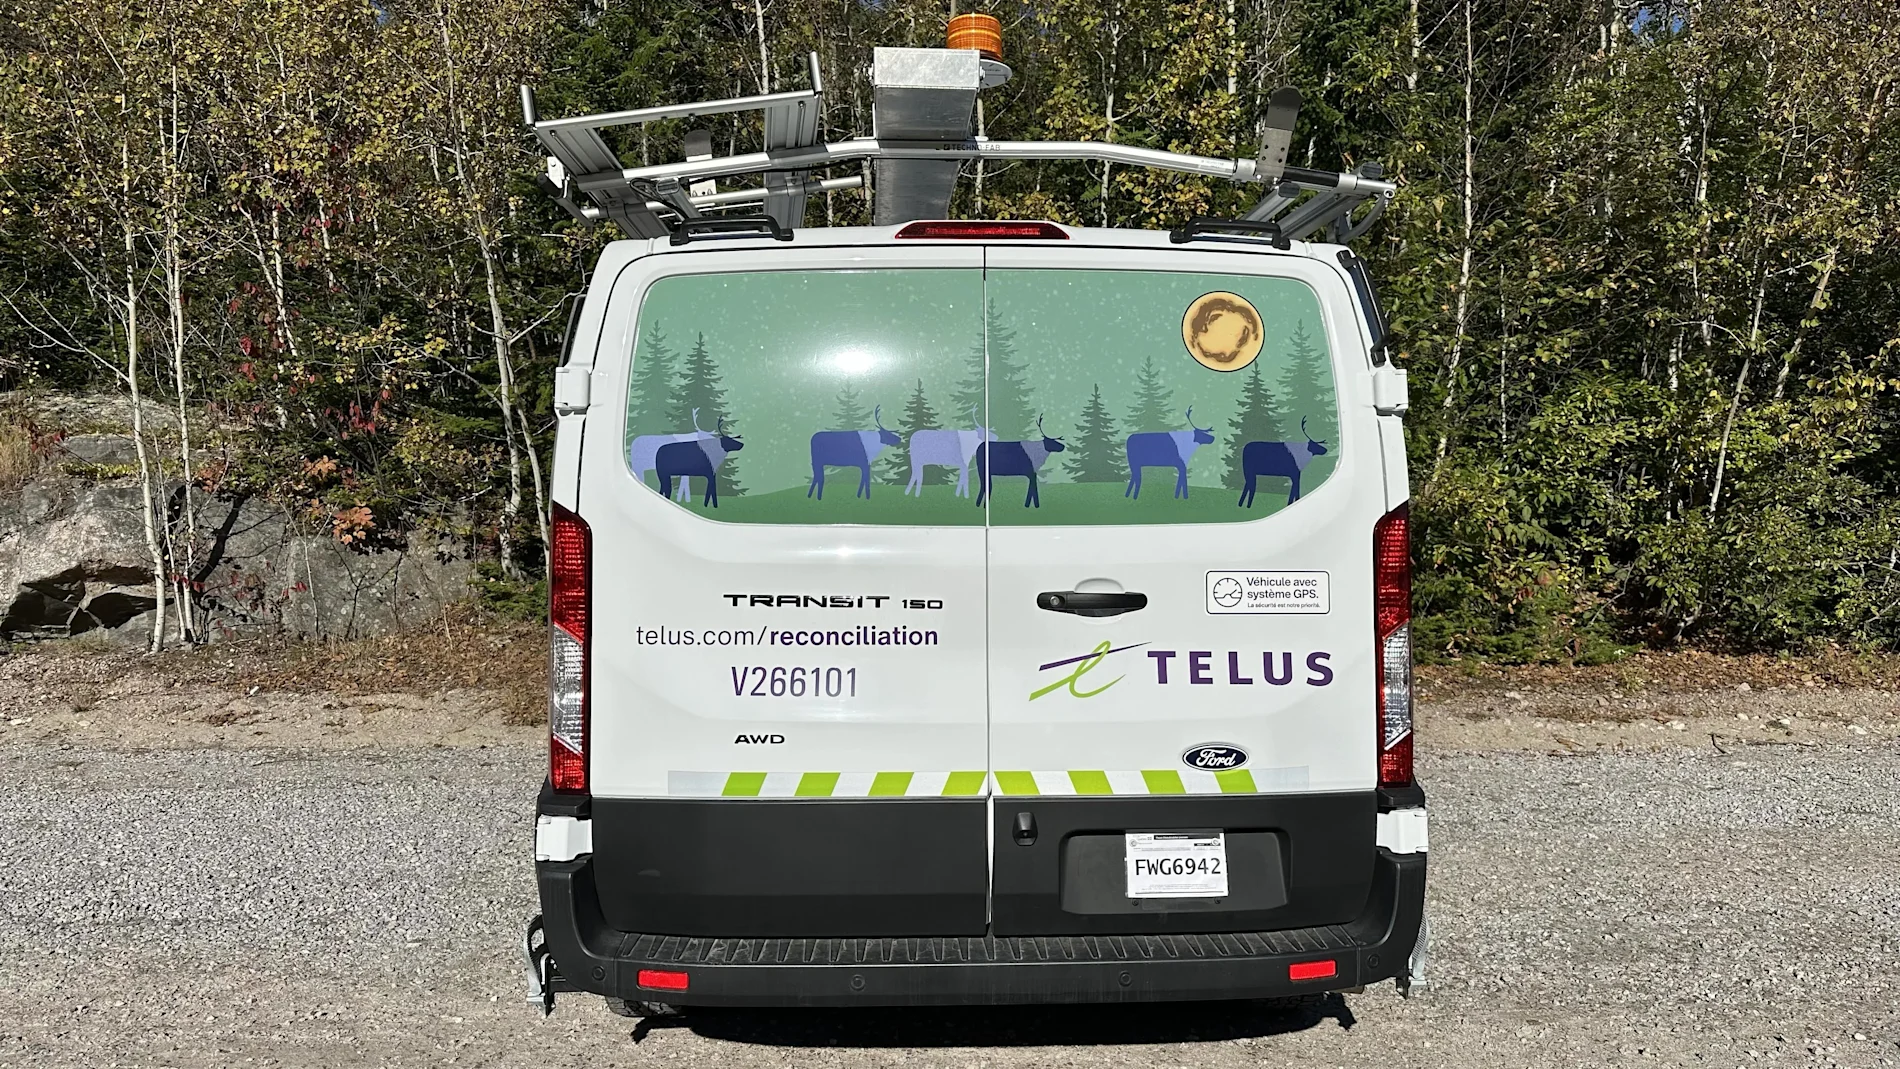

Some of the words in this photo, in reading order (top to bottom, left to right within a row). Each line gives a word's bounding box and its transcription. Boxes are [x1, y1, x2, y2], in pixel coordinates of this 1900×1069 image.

[1246, 576, 1291, 587] Véhicule
[1293, 579, 1317, 587] avec
[723, 594, 890, 609] TRANSIT
[901, 599, 943, 610] 150
[1247, 589, 1291, 601] système
[1293, 589, 1319, 599] GPS.
[636, 625, 938, 646] telus.com/reconciliation
[1147, 650, 1334, 687] TELUS
[731, 666, 856, 697] V266101
[734, 734, 785, 744] AWD
[1195, 748, 1236, 767] Ford
[1135, 857, 1222, 876] FWG6942
